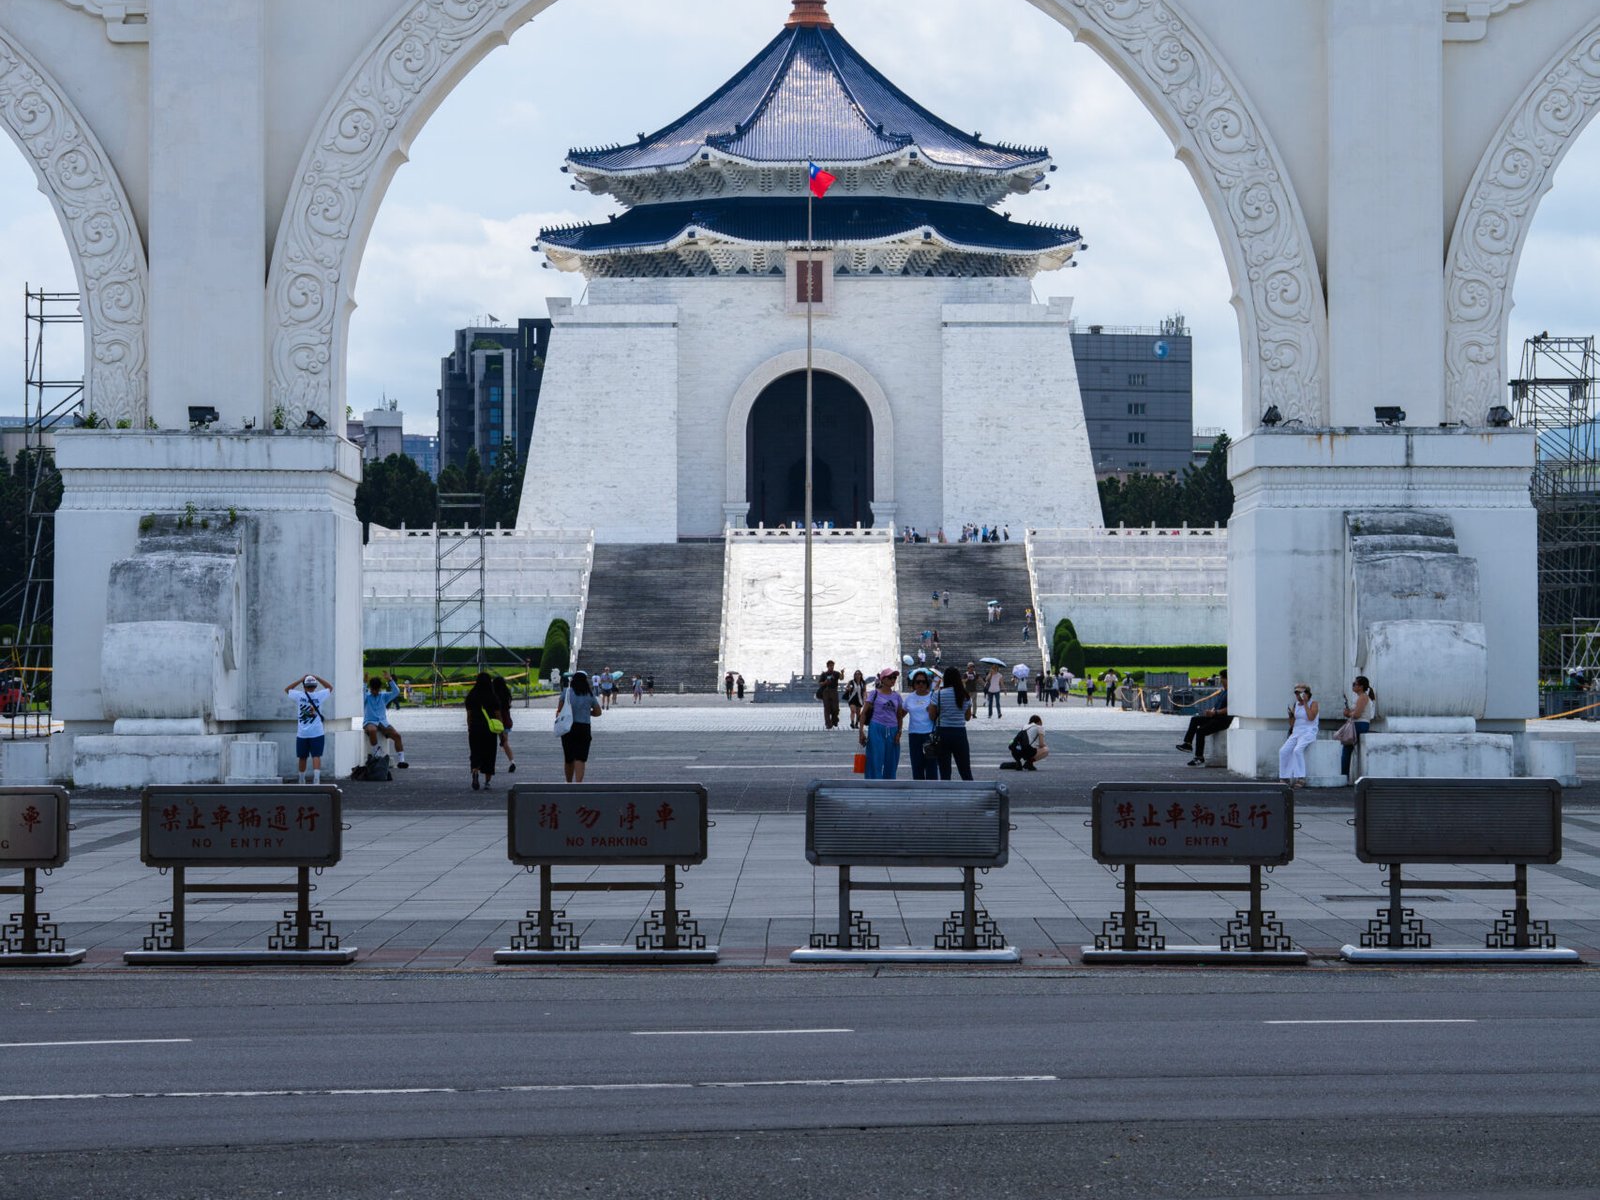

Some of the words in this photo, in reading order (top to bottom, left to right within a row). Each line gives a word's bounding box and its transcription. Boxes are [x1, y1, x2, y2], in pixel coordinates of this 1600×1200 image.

[537, 801, 676, 831] 請勿停車
[191, 837, 213, 848] NO
[230, 837, 285, 848] ENTRY
[565, 836, 585, 847] NO
[591, 836, 649, 847] PARKING
[1147, 835, 1167, 846] NO
[1185, 835, 1230, 846] ENTRY
